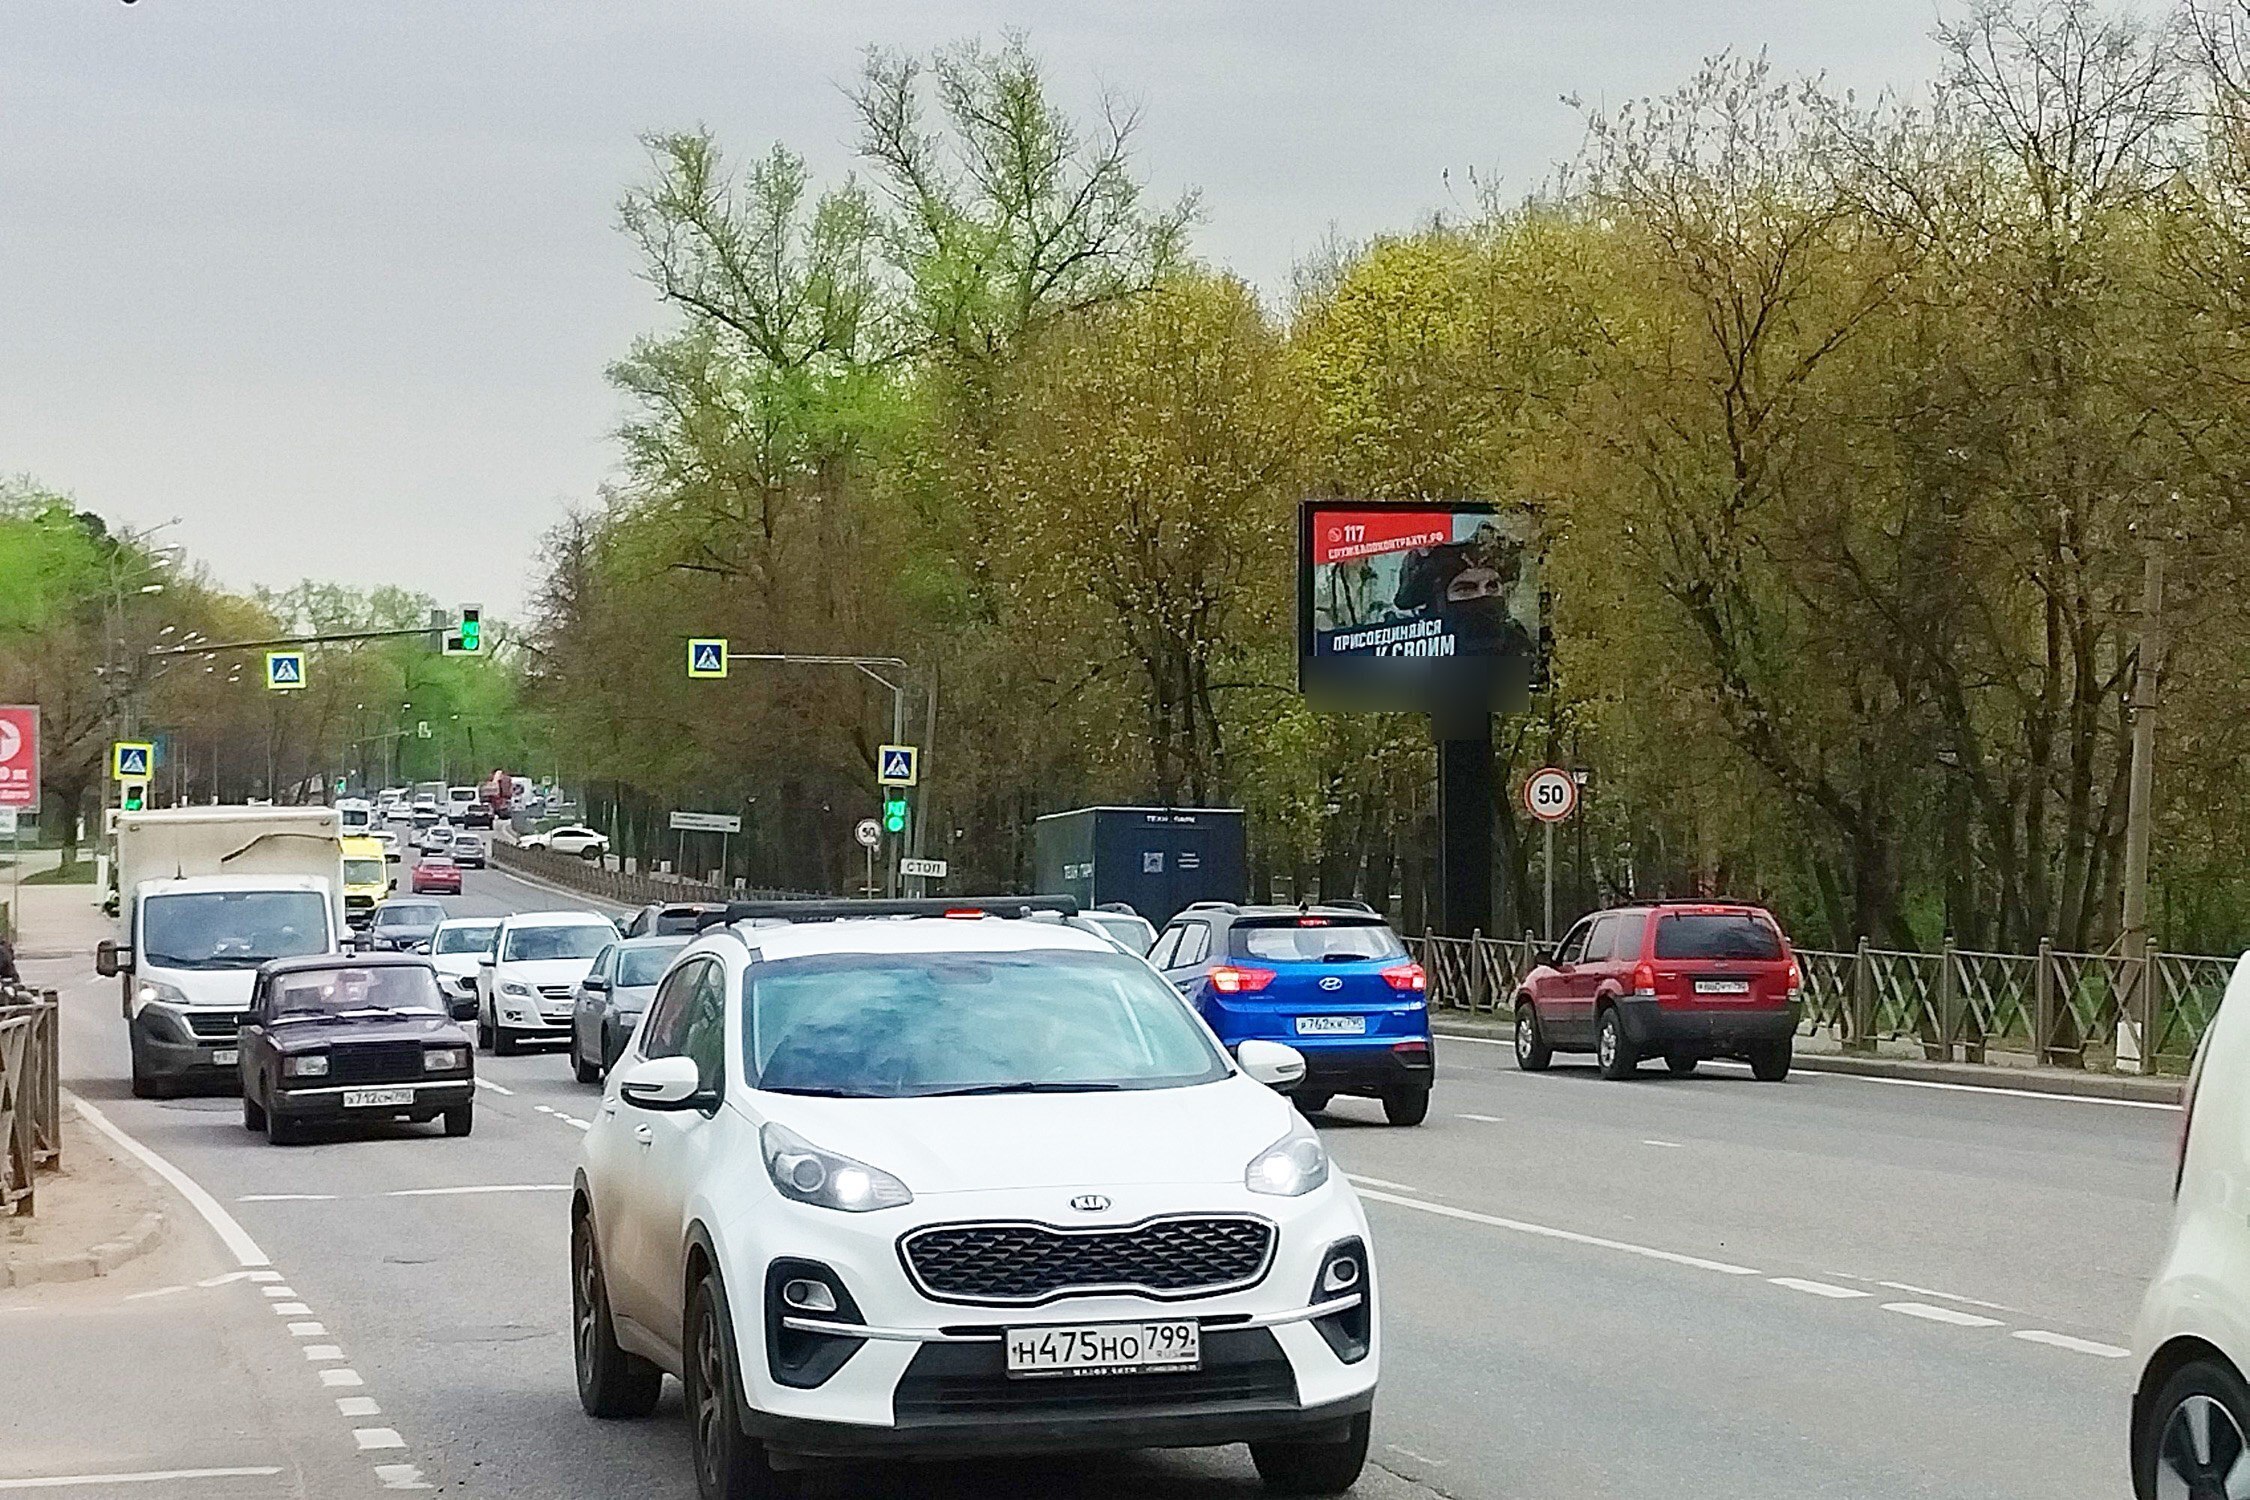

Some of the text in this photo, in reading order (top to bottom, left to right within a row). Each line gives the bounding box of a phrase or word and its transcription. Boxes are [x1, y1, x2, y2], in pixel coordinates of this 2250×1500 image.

[1344, 525, 1365, 542] 117
[1333, 619, 1442, 651] ПРИСОЕДИНЯЙСЯ
[1538, 785, 1563, 804] 50
[862, 827, 876, 838] 50
[906, 862, 941, 874] СТОП
[1073, 1195, 1108, 1209] KIA
[1145, 1325, 1190, 1349] 799
